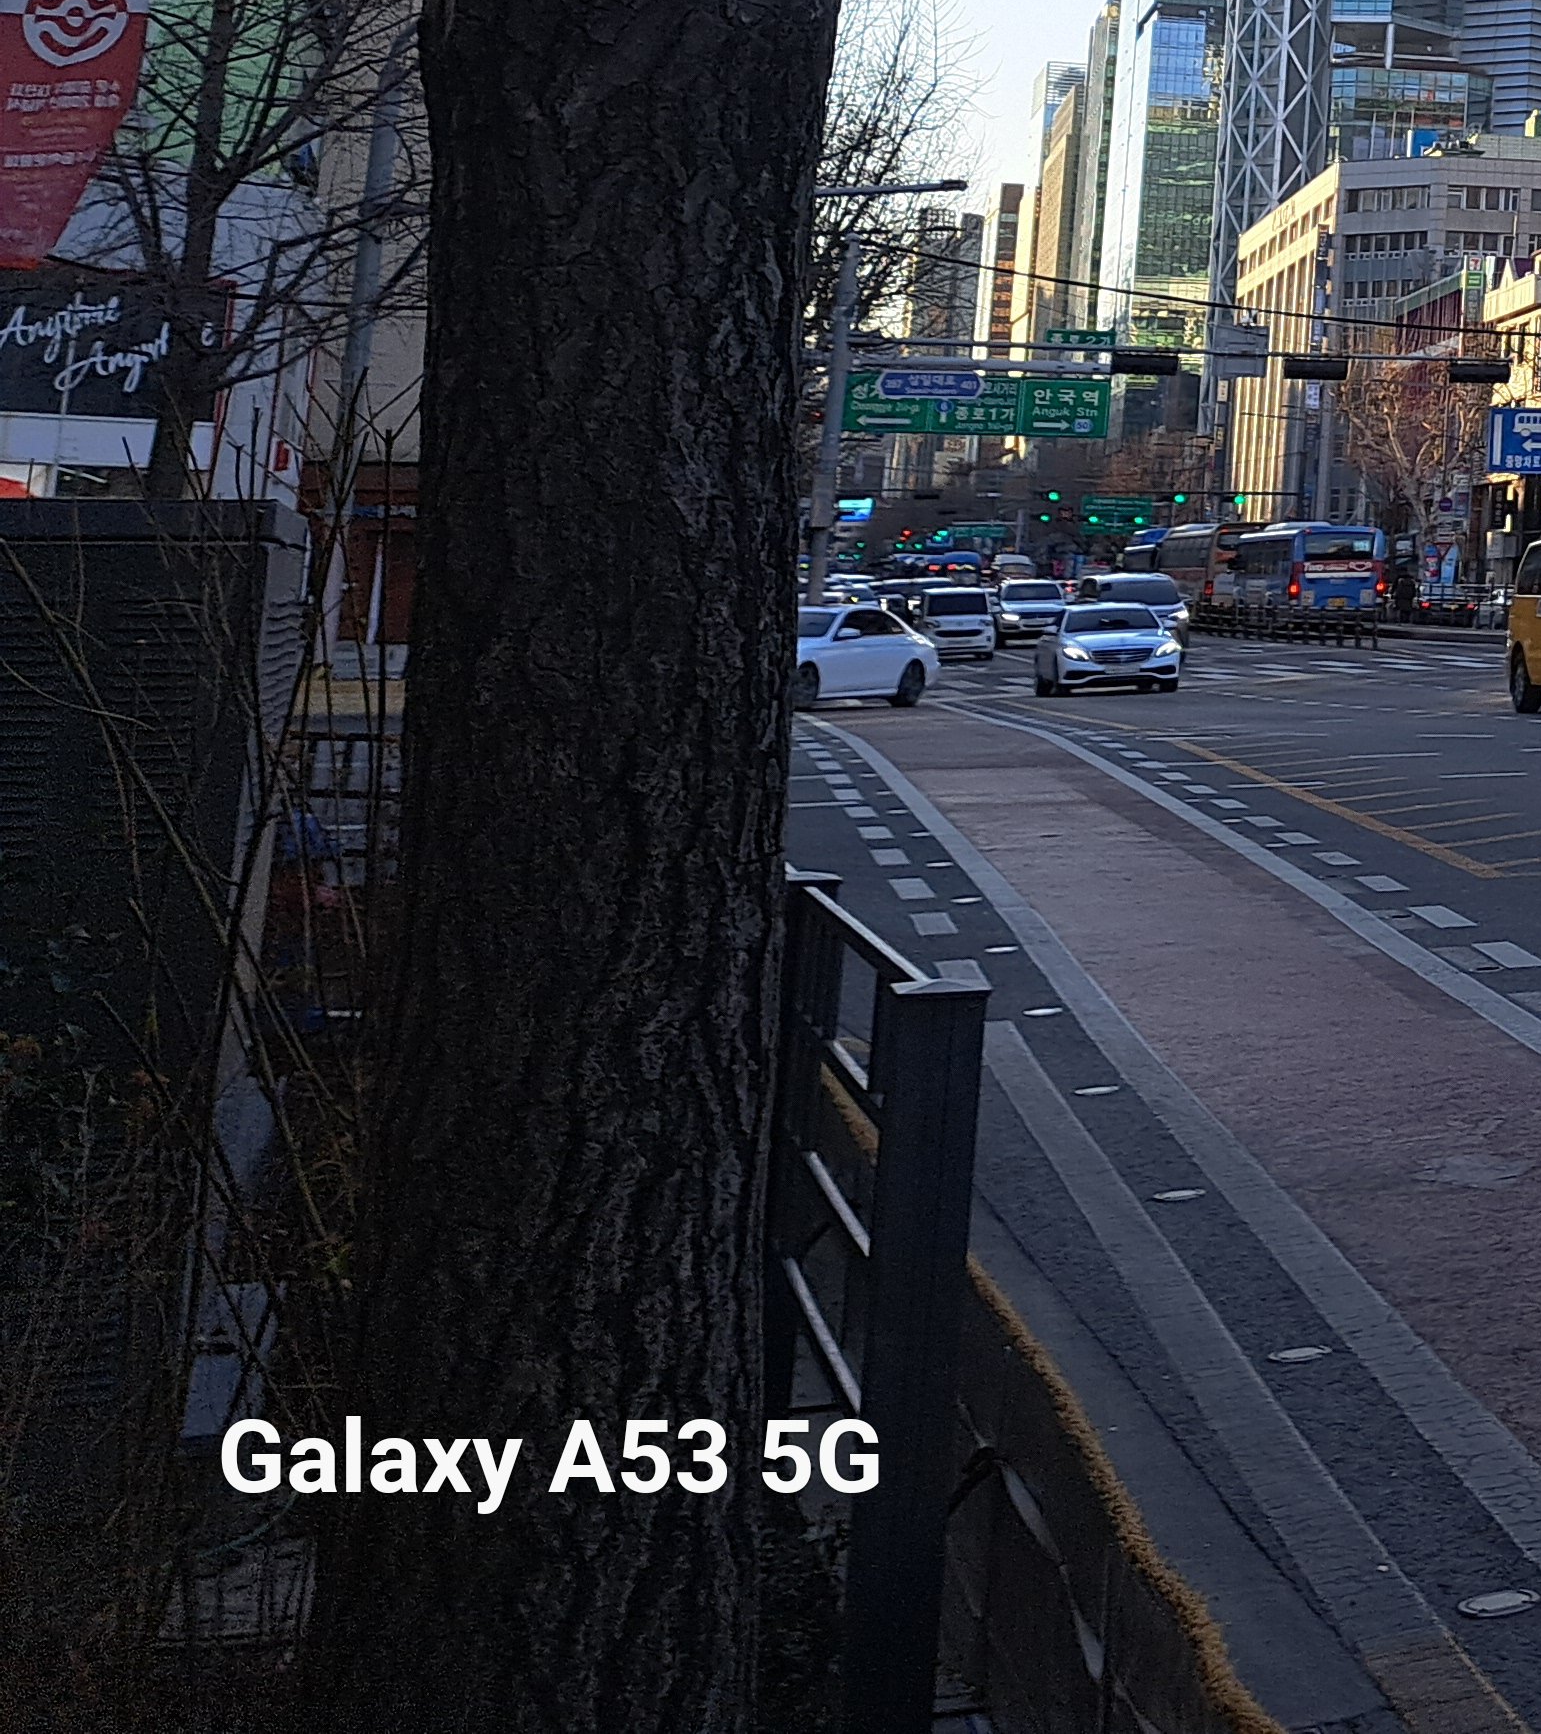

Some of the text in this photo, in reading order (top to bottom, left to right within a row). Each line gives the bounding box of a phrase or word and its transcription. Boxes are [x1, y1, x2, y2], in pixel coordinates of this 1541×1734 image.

[1033, 389, 1099, 407] 안국역
[954, 406, 1015, 421] 종로1가
[1032, 406, 1098, 418] Anguk Stn
[1076, 420, 1089, 430] 50
